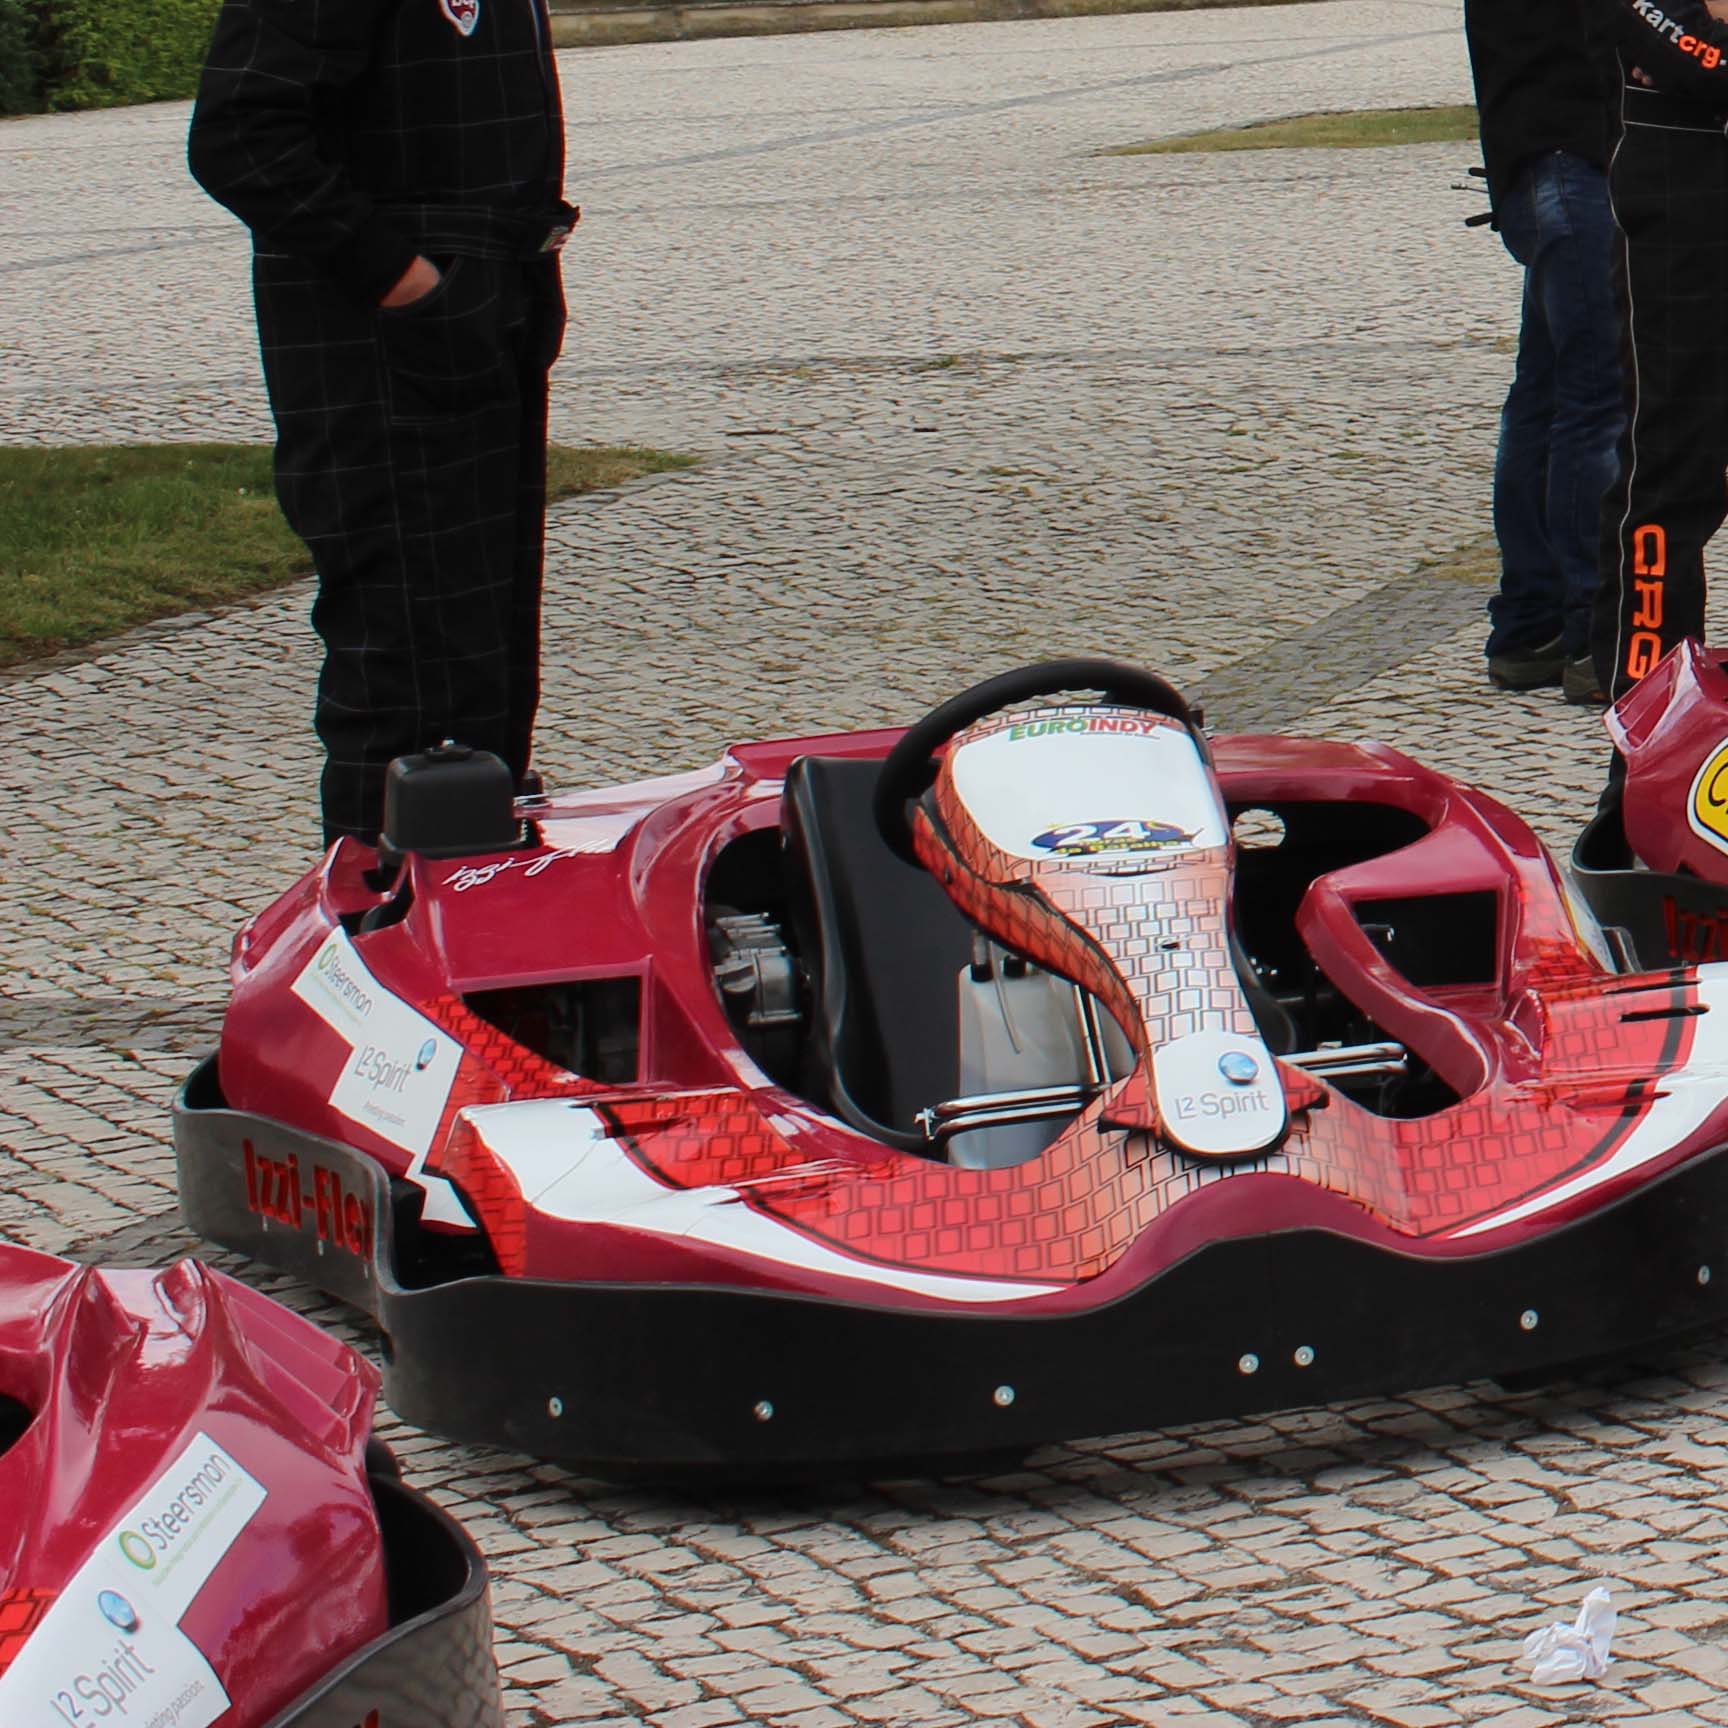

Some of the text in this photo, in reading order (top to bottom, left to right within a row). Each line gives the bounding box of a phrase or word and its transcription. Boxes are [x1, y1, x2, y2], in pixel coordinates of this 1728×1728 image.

[1630, 524, 1667, 679] CRG
[1008, 718, 1158, 741] EUROINDY
[1054, 822, 1151, 846] 24
